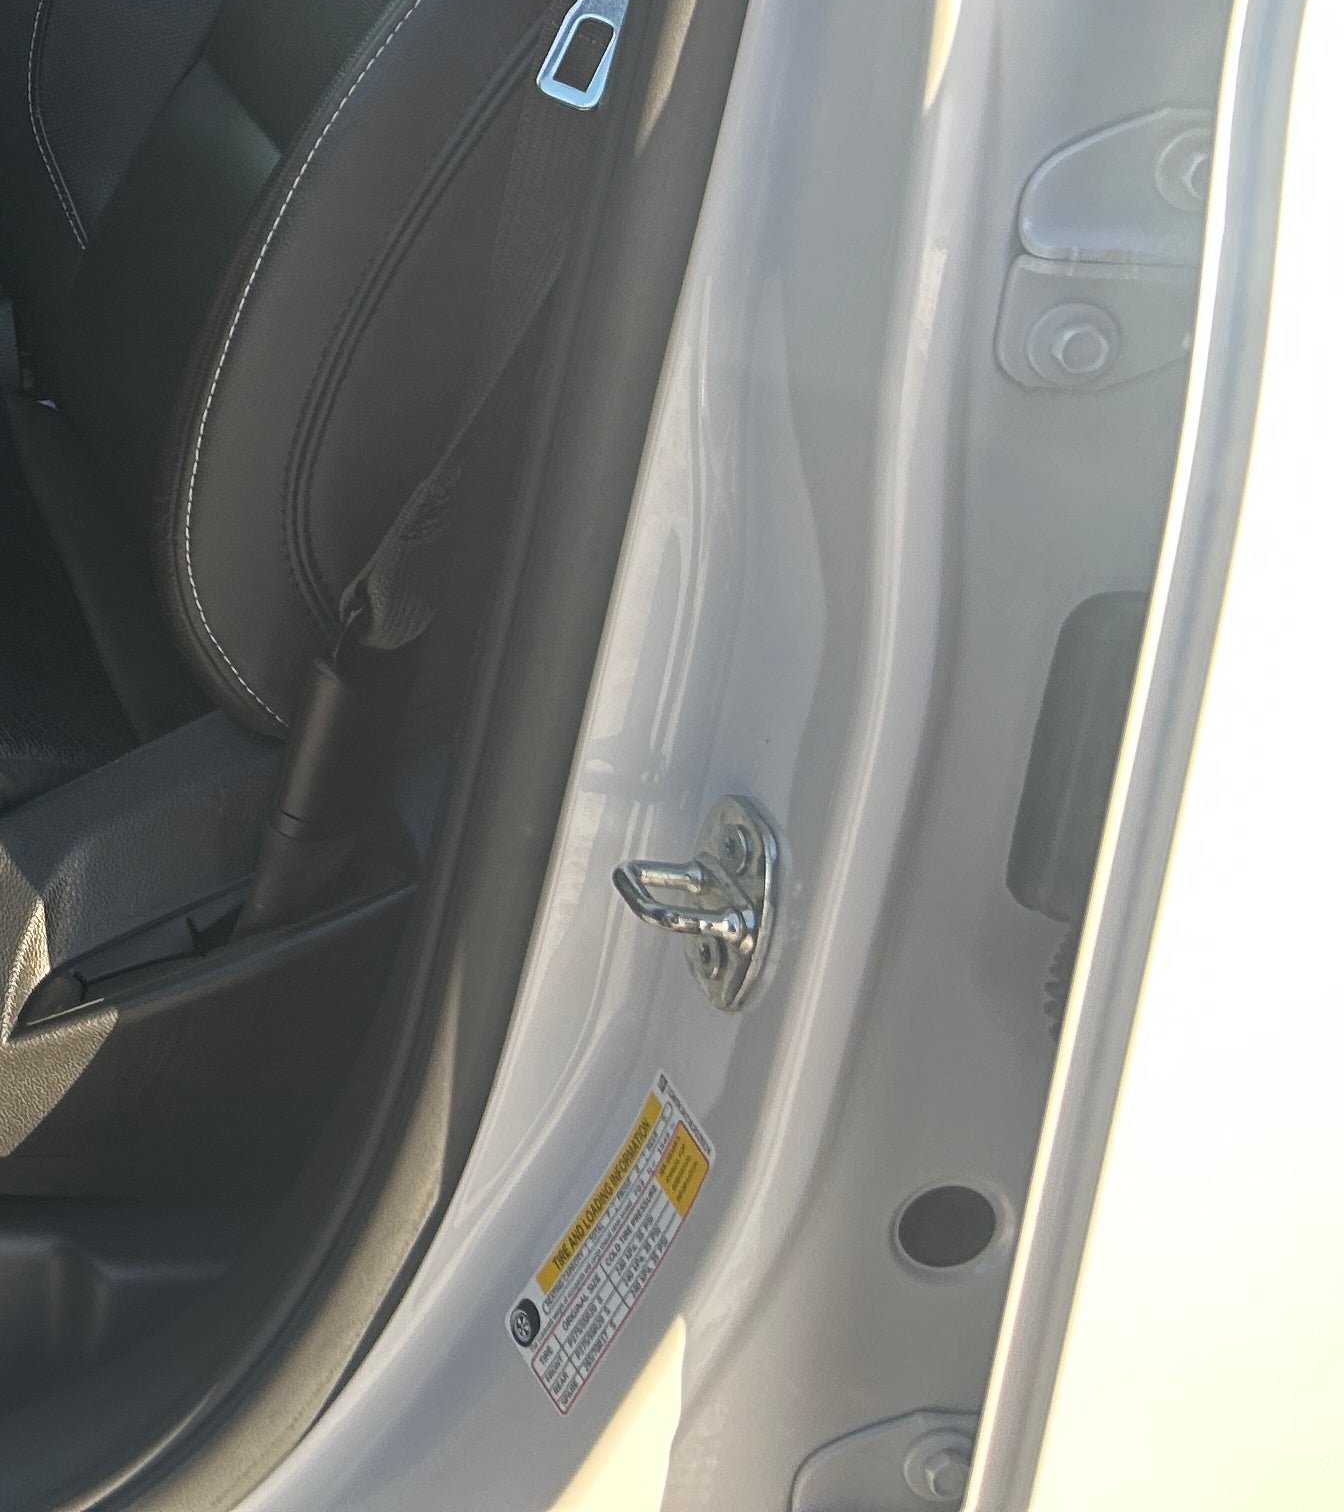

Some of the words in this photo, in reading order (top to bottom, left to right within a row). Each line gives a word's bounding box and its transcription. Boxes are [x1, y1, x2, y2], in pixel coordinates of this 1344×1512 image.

[551, 1242, 571, 1271] TIRE
[566, 1222, 585, 1250] AND
[580, 1178, 613, 1229] LOADING
[608, 1116, 651, 1186] INFORMATION
